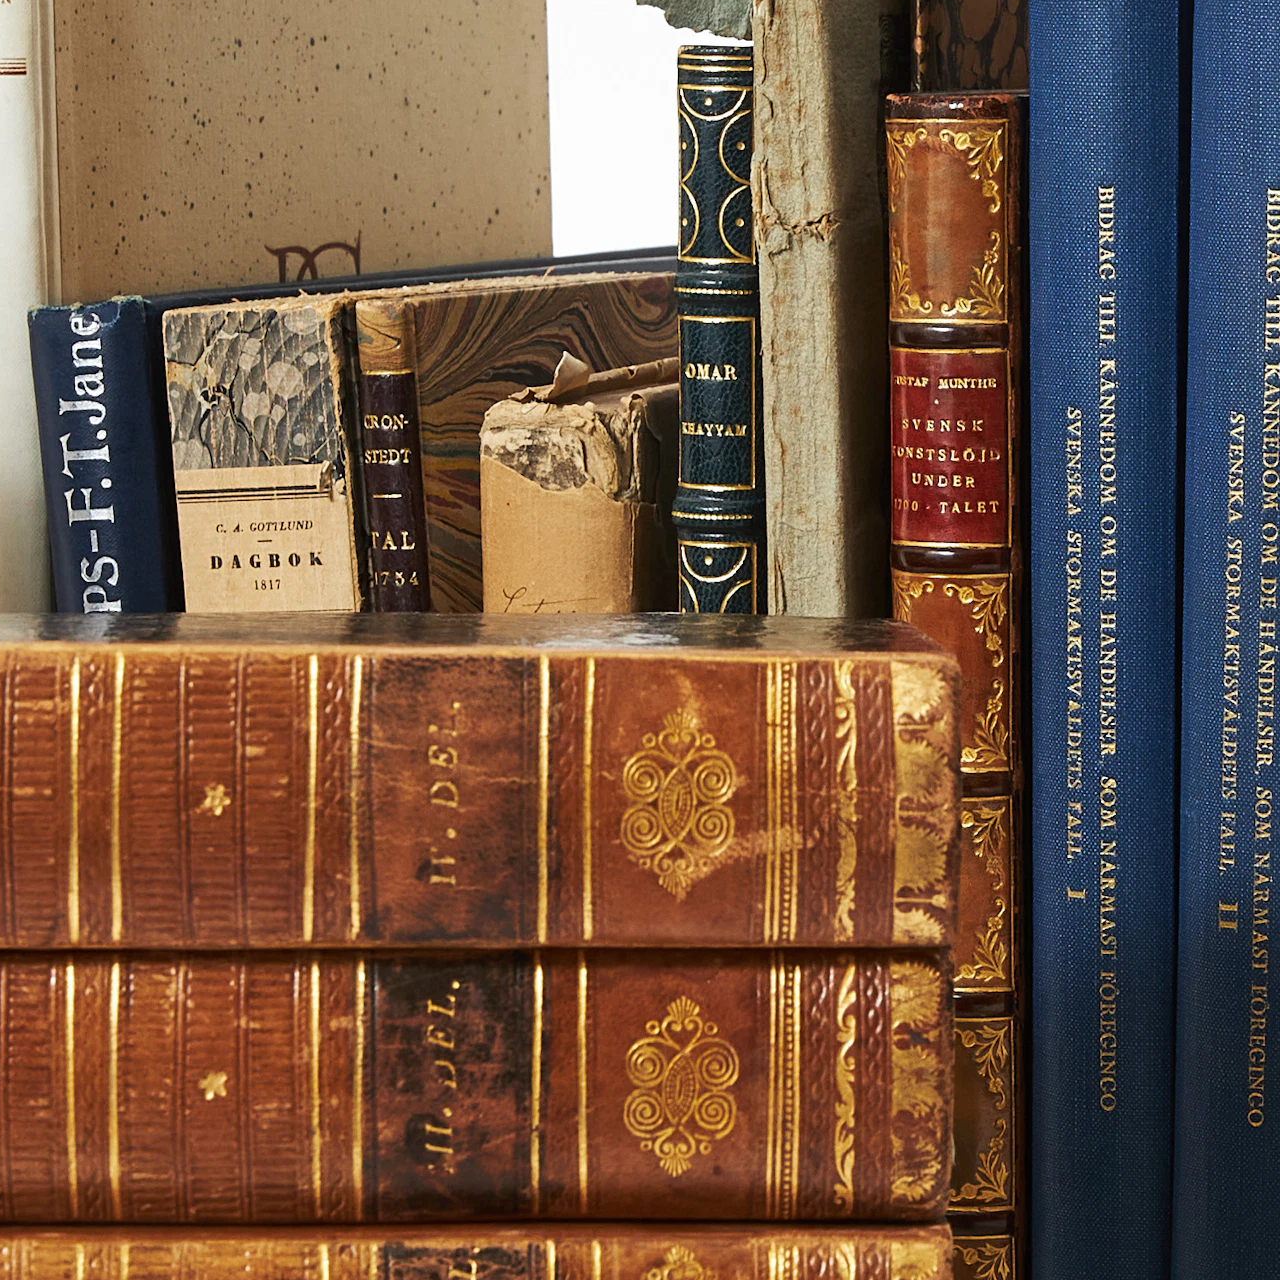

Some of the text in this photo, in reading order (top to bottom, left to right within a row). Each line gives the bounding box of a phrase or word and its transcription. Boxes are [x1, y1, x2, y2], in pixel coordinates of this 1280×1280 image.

[1097, 185, 1116, 280] BIDRAG
[684, 363, 738, 380] OMAR
[938, 377, 997, 389] MUNTHE
[364, 413, 409, 430] CRON-
[681, 422, 748, 437] KHAYYAM
[902, 418, 983, 432] SVENSK
[365, 448, 412, 465] STEDT
[1066, 406, 1083, 516] SVENSKA
[1226, 410, 1246, 524] SVENSKA
[912, 472, 976, 488] UNDER
[1099, 515, 1117, 558] OM
[1260, 521, 1279, 563] OM
[211, 551, 324, 570] DAGBOK
[254, 579, 281, 590] 1817
[1099, 568, 1117, 603] DE
[1259, 576, 1277, 609] DE
[1099, 775, 1117, 830] SOM
[1254, 785, 1273, 842] SOM
[1218, 900, 1239, 933] II
